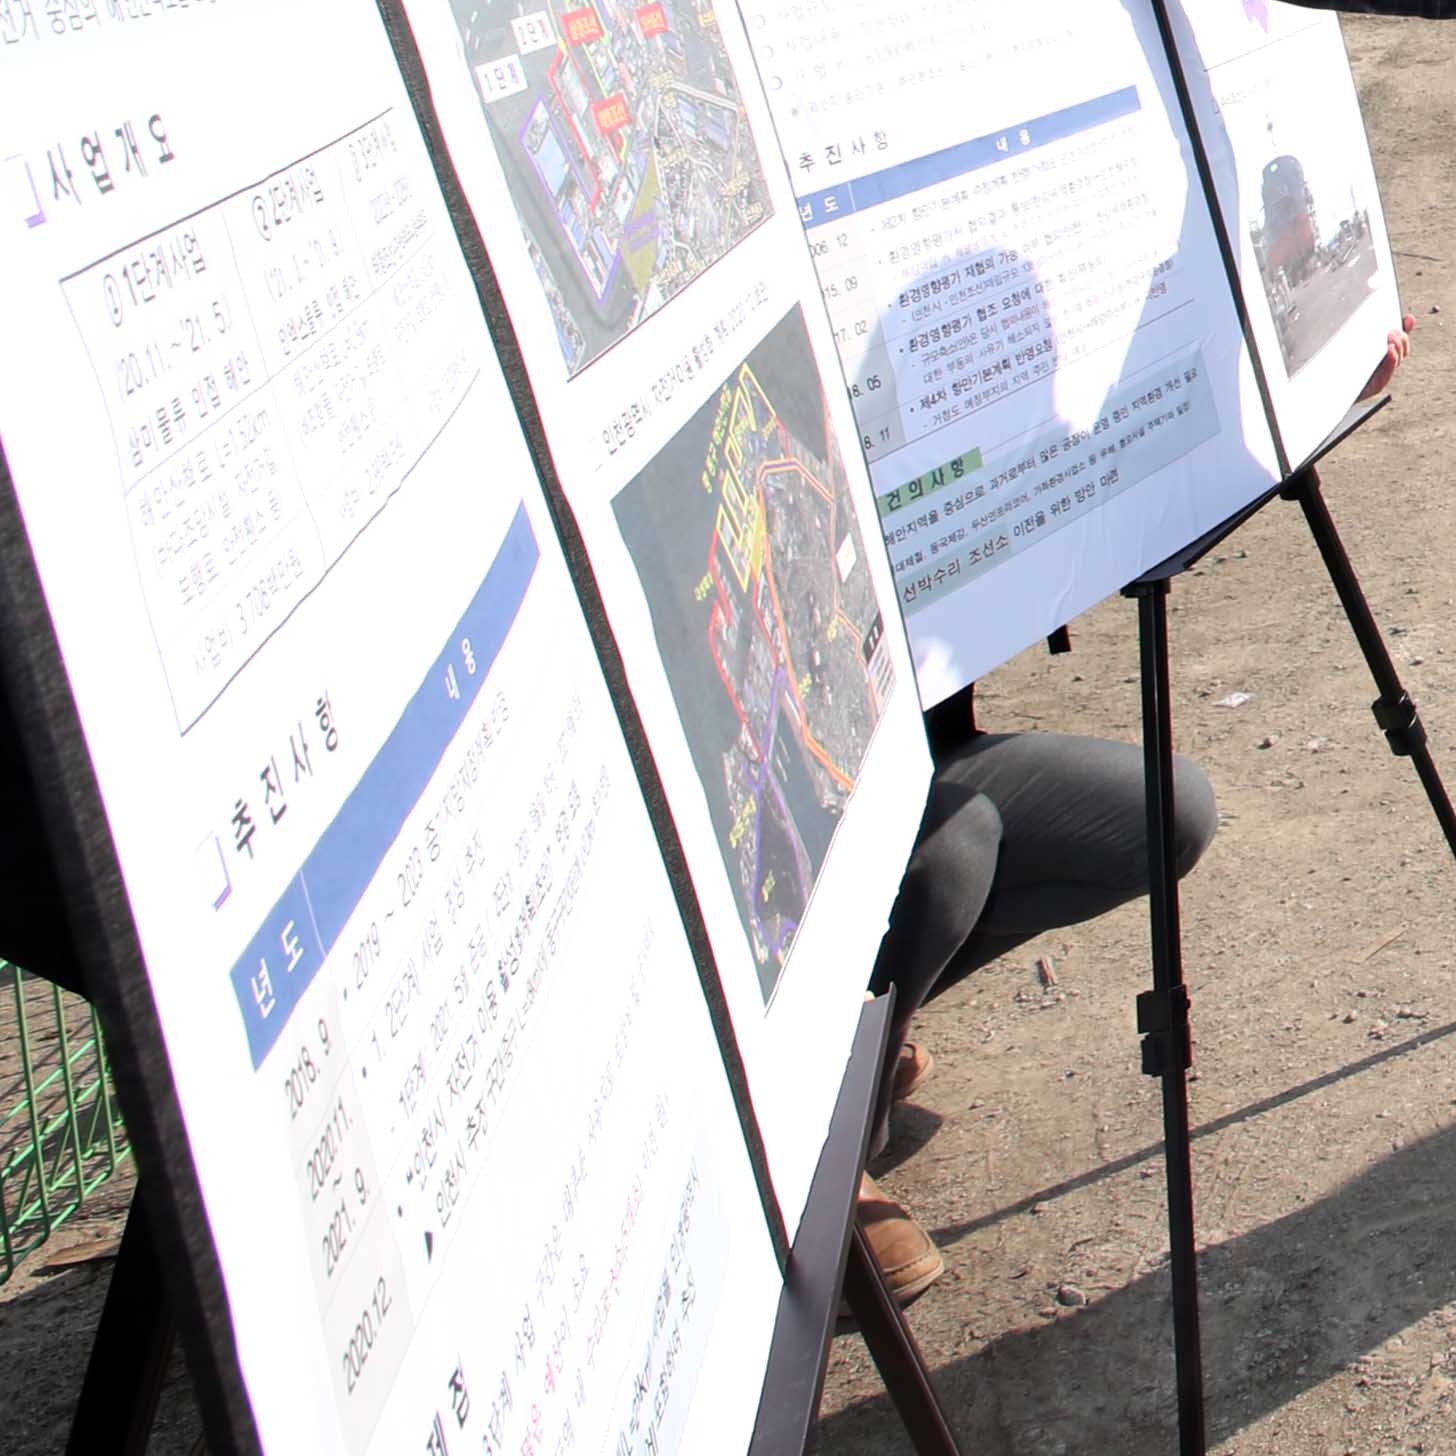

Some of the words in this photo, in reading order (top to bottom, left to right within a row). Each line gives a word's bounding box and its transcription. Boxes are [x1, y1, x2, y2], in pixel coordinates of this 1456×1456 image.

[836, 233, 849, 248] 12
[867, 374, 883, 392] 05
[879, 426, 892, 443] 11
[886, 458, 964, 511] 건의사항
[903, 559, 961, 603] 선박수리
[969, 535, 1008, 566] 조선소
[1013, 510, 1046, 537] 이전을
[229, 687, 340, 862] 추진사항
[249, 918, 304, 1021] 년도
[352, 918, 383, 993] 2019
[283, 1045, 322, 1122] 2018.
[321, 1199, 357, 1279] 2021.
